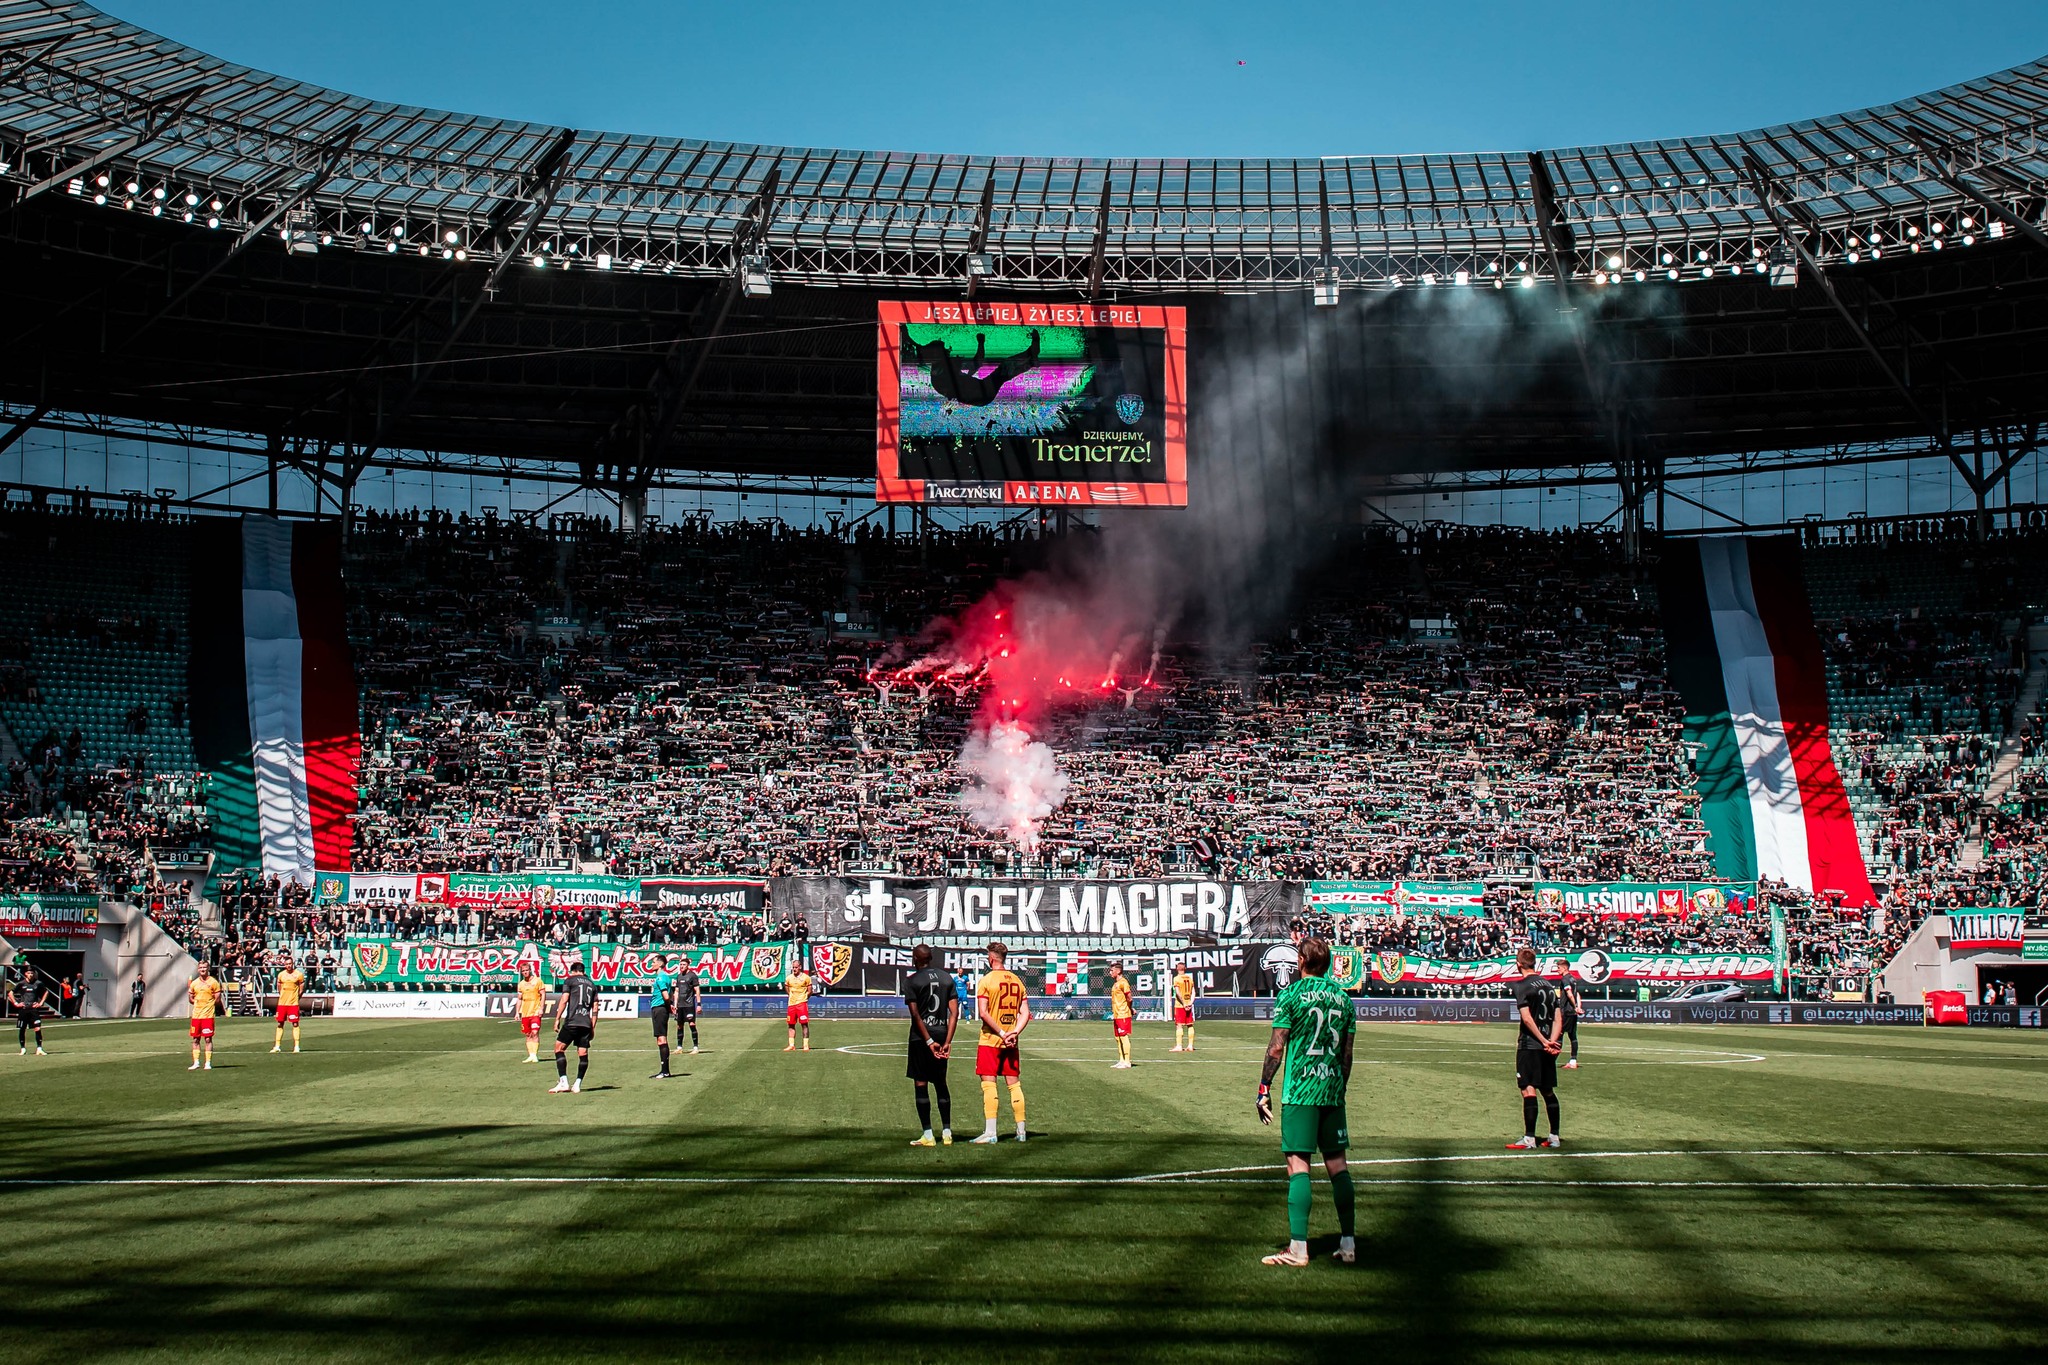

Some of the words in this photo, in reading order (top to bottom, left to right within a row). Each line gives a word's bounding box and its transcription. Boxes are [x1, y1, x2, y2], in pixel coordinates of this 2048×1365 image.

[924, 308, 964, 321] JESZ
[967, 307, 1022, 323] LEPIEJ,
[1029, 305, 1084, 323] ŻYJESZ
[1091, 310, 1142, 324] LEPIEJ
[1083, 431, 1145, 443] DZIĘKUJEMY,
[1031, 438, 1152, 464] Trenerze!
[926, 483, 1002, 500] TARCZYŃSKI
[1014, 485, 1081, 500] ARENA
[553, 616, 569, 625] B23
[847, 623, 863, 631] B24
[1426, 629, 1442, 637] B26
[170, 853, 189, 862] B10
[536, 858, 553, 867] B11
[861, 862, 880, 870] B12
[1179, 864, 1197, 873] B13
[1497, 866, 1516, 875] B14
[354, 884, 412, 899] WOŁÓW
[454, 883, 532, 901] BIELANY
[556, 889, 619, 906] Strzegom
[658, 887, 697, 909] ŚRODA
[700, 889, 747, 910] ŚLĄSKA
[1319, 891, 1382, 904] BRZEG
[1565, 887, 1658, 915] OLEŚNICA
[895, 897, 916, 925] P.
[918, 885, 1046, 933] JACEK
[1059, 882, 1254, 939] MAGIERA
[1949, 914, 2021, 941] MILICZ
[1539, 946, 1572, 954] TACY
[1611, 946, 1665, 954] KTÓRZY
[1671, 946, 1692, 954] NIE
[1745, 946, 1773, 954] WIA
[391, 942, 544, 978] TWIERDZA
[590, 944, 751, 983] WROCŁAW
[861, 947, 915, 968] NAS
[233, 969, 242, 981] 5
[1413, 956, 1562, 981] LUDZIE
[1625, 956, 1772, 977] ZASAD
[480, 974, 514, 983] BASTION
[1837, 979, 1856, 991] 10
[1183, 979, 1190, 993] 11
[1431, 982, 1462, 990] WKS
[578, 984, 593, 1007] 15
[928, 982, 940, 1013] 5
[998, 982, 1020, 1010] 29
[362, 999, 406, 1010] Nawrot
[438, 999, 481, 1010] Nawrot
[1538, 989, 1556, 1021] 33
[1942, 1004, 1965, 1013] Betclic
[1481, 1007, 1500, 1017] na
[1690, 1004, 1736, 1021] Wejdź
[1740, 1009, 1759, 1019] na
[1992, 1012, 2011, 1023] na
[1305, 1006, 1343, 1057] 25
